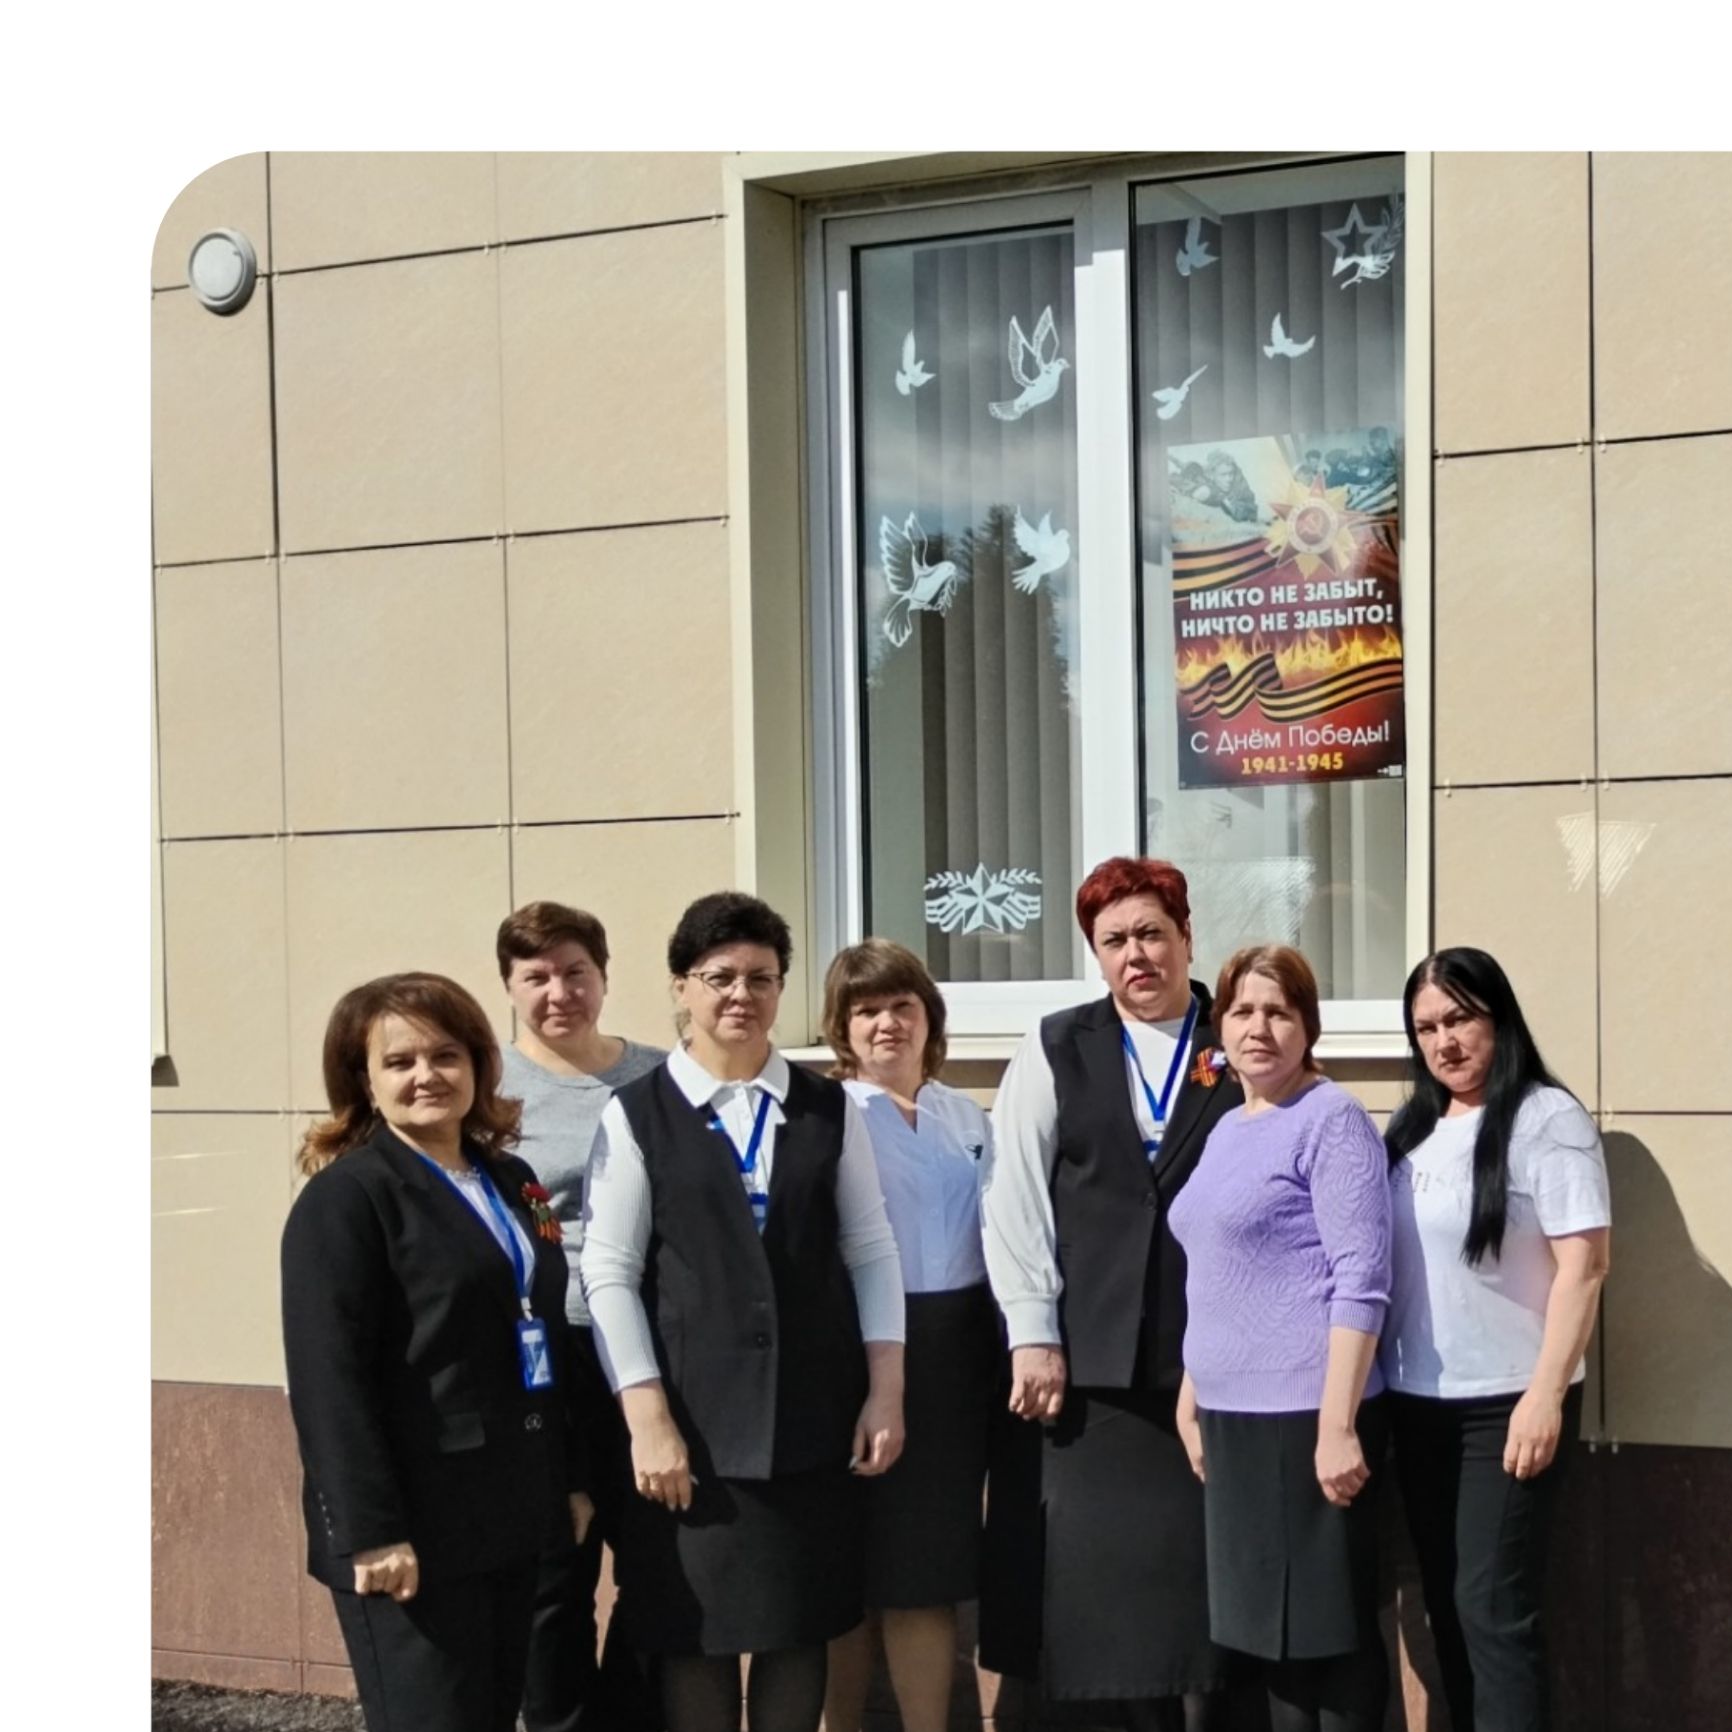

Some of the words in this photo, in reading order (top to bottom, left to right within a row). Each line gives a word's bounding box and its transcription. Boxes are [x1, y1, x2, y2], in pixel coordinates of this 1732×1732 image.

[1190, 587, 1264, 611] НИКТО
[1270, 584, 1298, 605] НЕ
[1304, 578, 1384, 602] ЗАБЫТ,
[1181, 613, 1254, 638] НИЧТО
[1260, 611, 1287, 632] НЕ
[1294, 604, 1393, 630] ЗАБЫТО!
[1191, 730, 1210, 753] С
[1216, 726, 1281, 756] Днём
[1289, 721, 1390, 748] Победы!
[1241, 752, 1344, 775] 1941-1945
